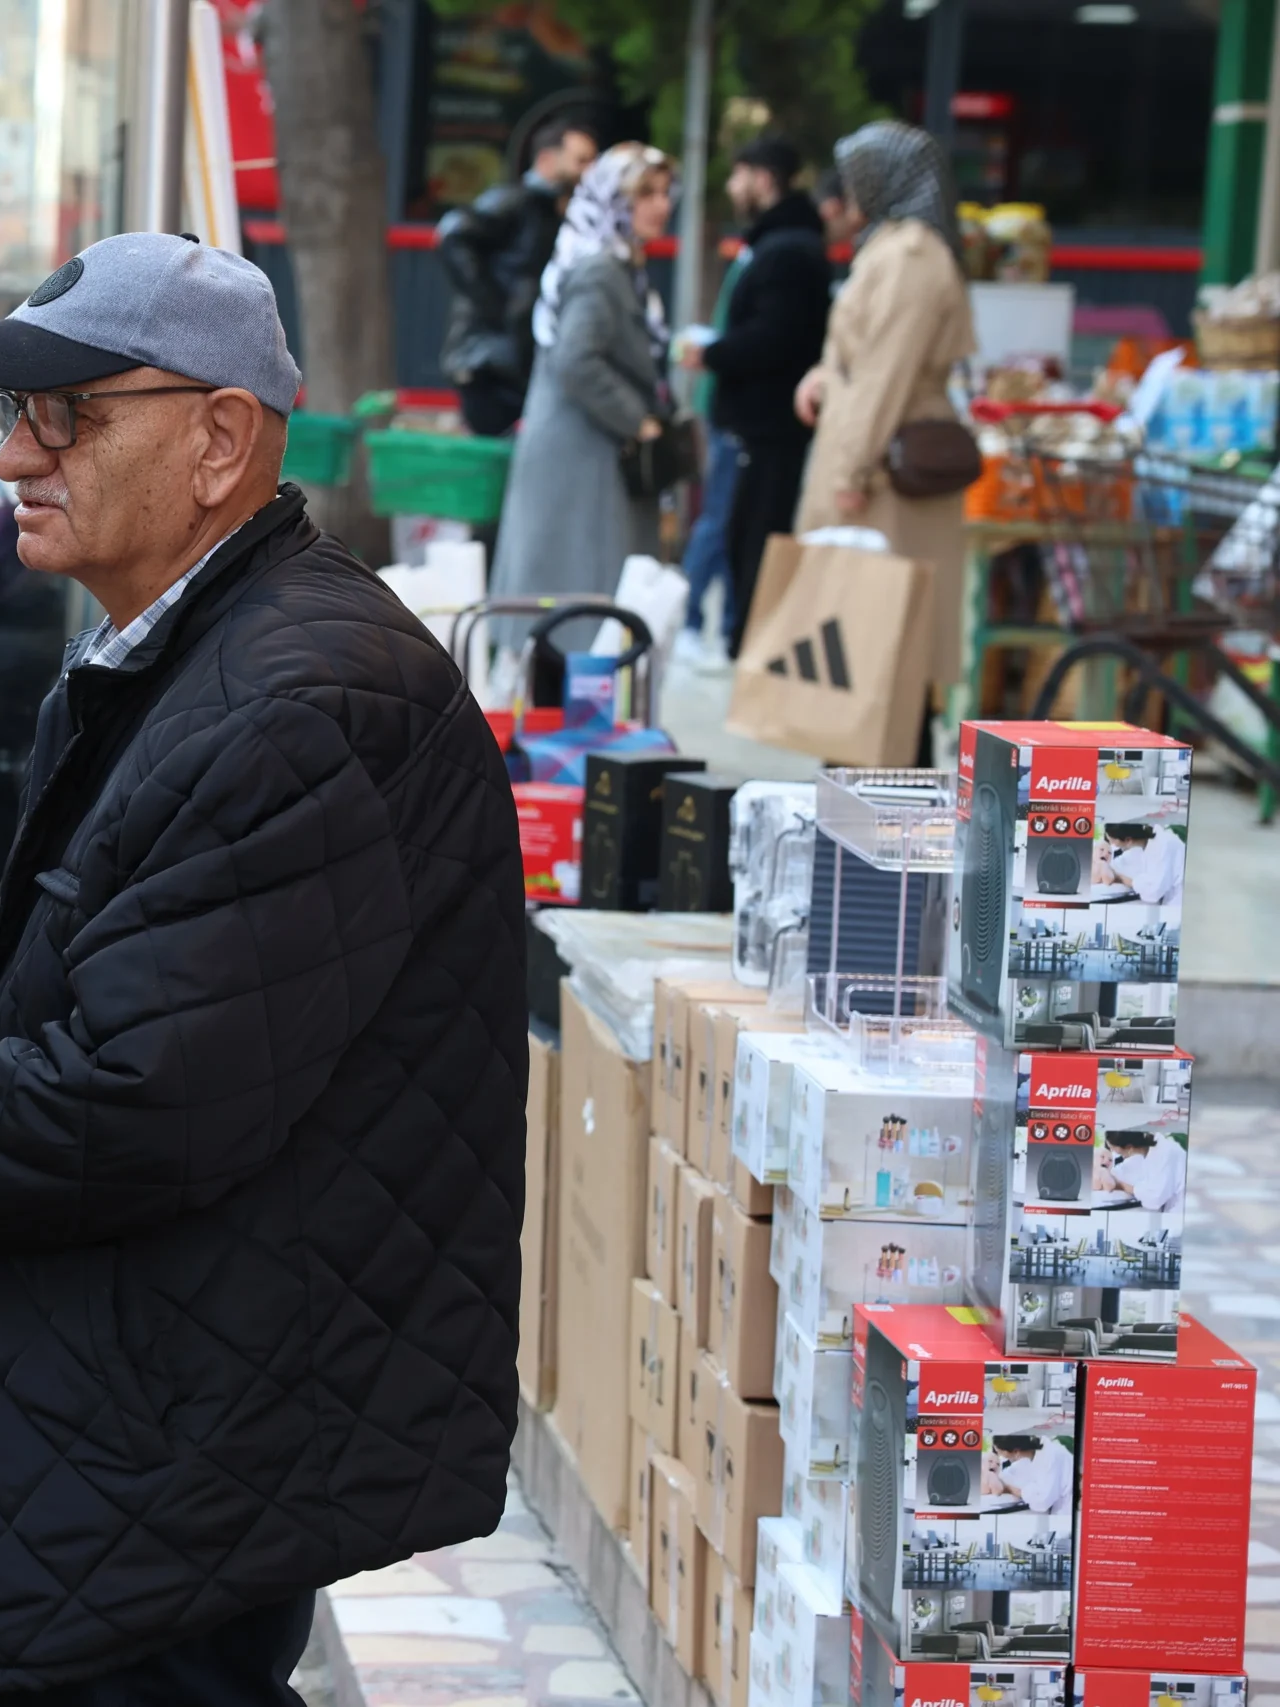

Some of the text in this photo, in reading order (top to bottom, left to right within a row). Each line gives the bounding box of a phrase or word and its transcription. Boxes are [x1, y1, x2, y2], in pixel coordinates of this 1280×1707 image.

[1035, 775, 1092, 793] Aprilla
[1078, 805, 1092, 813] Fan
[1035, 1083, 1092, 1100] Aprilla
[1078, 1112, 1092, 1120] Fan
[1096, 1376, 1135, 1389] Aprilla
[924, 1390, 979, 1407] Aprilla
[966, 1418, 979, 1426] Fan
